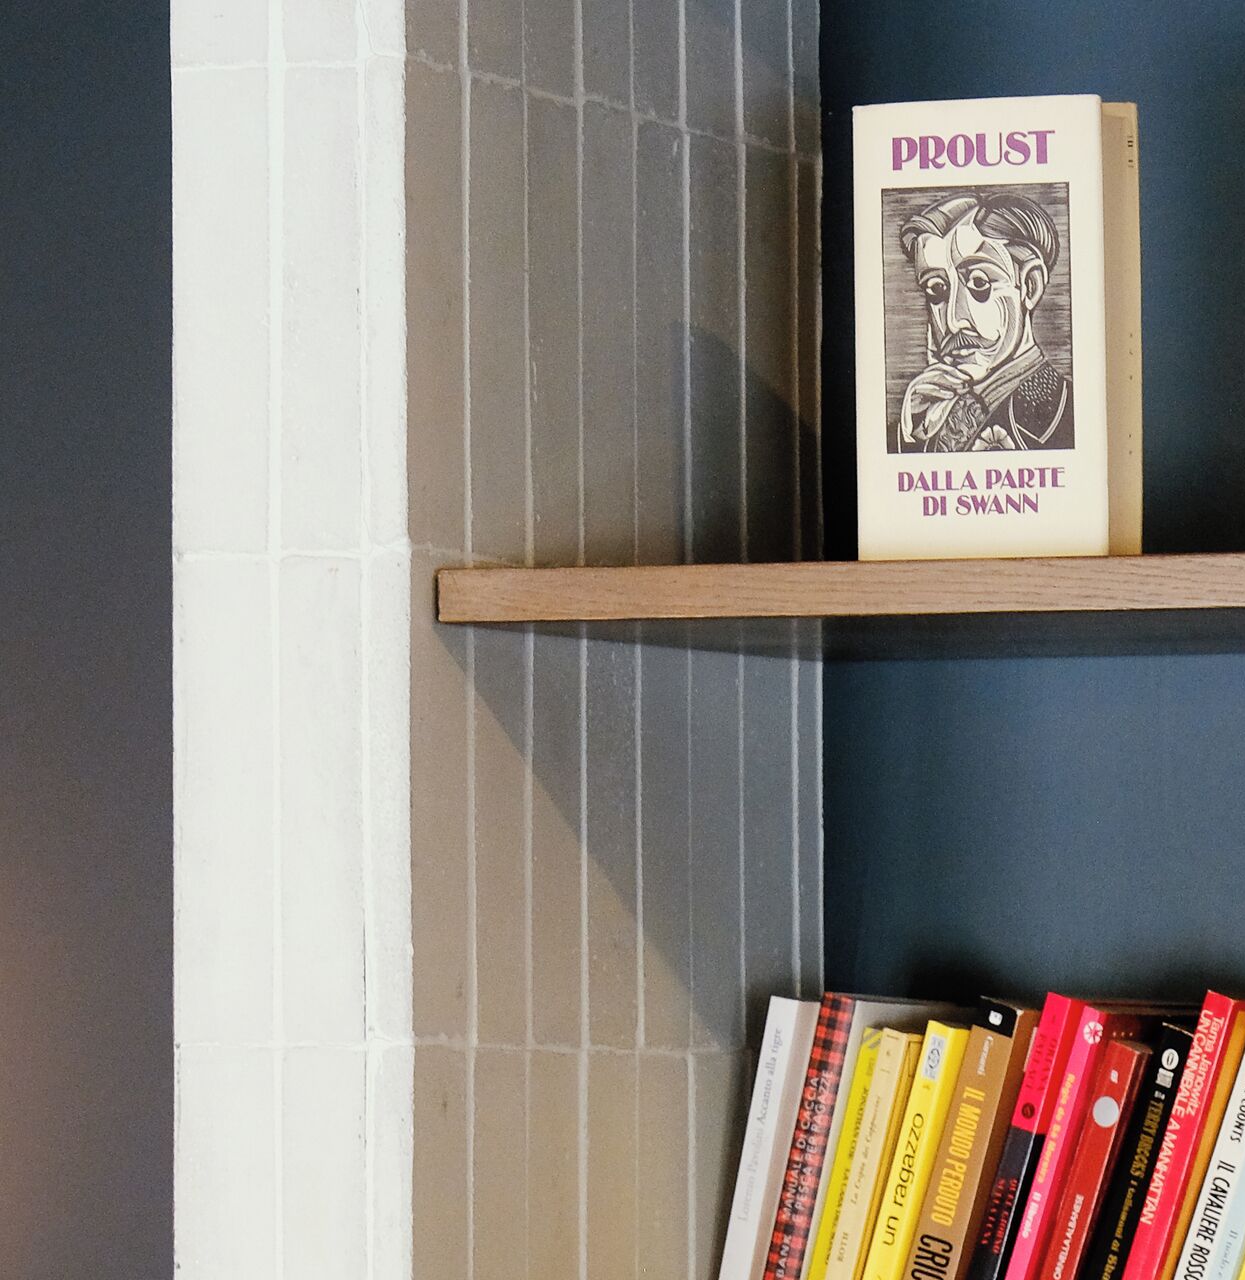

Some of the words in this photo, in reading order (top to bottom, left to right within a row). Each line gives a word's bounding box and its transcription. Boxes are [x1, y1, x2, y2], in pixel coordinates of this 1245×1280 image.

[892, 130, 1056, 171] PROUST
[898, 469, 980, 493] DALLA
[985, 466, 1066, 491] PARTE
[923, 495, 947, 516] DI
[955, 492, 1040, 516] SWANN
[1197, 1008, 1213, 1027] UN
[1203, 1014, 1224, 1052] Tama
[769, 1028, 783, 1053] tigre
[764, 1056, 776, 1075] alla
[1171, 1023, 1207, 1116] CANNIBALE
[1186, 1053, 1213, 1117] Janowitz
[755, 1079, 772, 1124] Accanto
[800, 1076, 819, 1130] CACCIA
[810, 1070, 833, 1132] RAGAZZE
[962, 1086, 984, 1101] IL
[948, 1102, 981, 1159] MONDO
[1142, 1100, 1163, 1134] TERRY
[1167, 1119, 1180, 1133] A
[796, 1132, 807, 1148] DI
[804, 1138, 819, 1163] PER
[1130, 1133, 1153, 1177] BROOKS
[781, 1149, 804, 1218] MANUALE
[795, 1165, 813, 1210] PESCA
[882, 1215, 899, 1245] un
[892, 1113, 925, 1207] ragazzo
[1140, 1131, 1176, 1224] MANHATTAN
[1216, 1160, 1235, 1173] IL
[930, 1158, 966, 1226] PERDUTO
[1196, 1176, 1230, 1243] CAVALIERE
[792, 1213, 804, 1222] E
[775, 1234, 791, 1278] BANK
